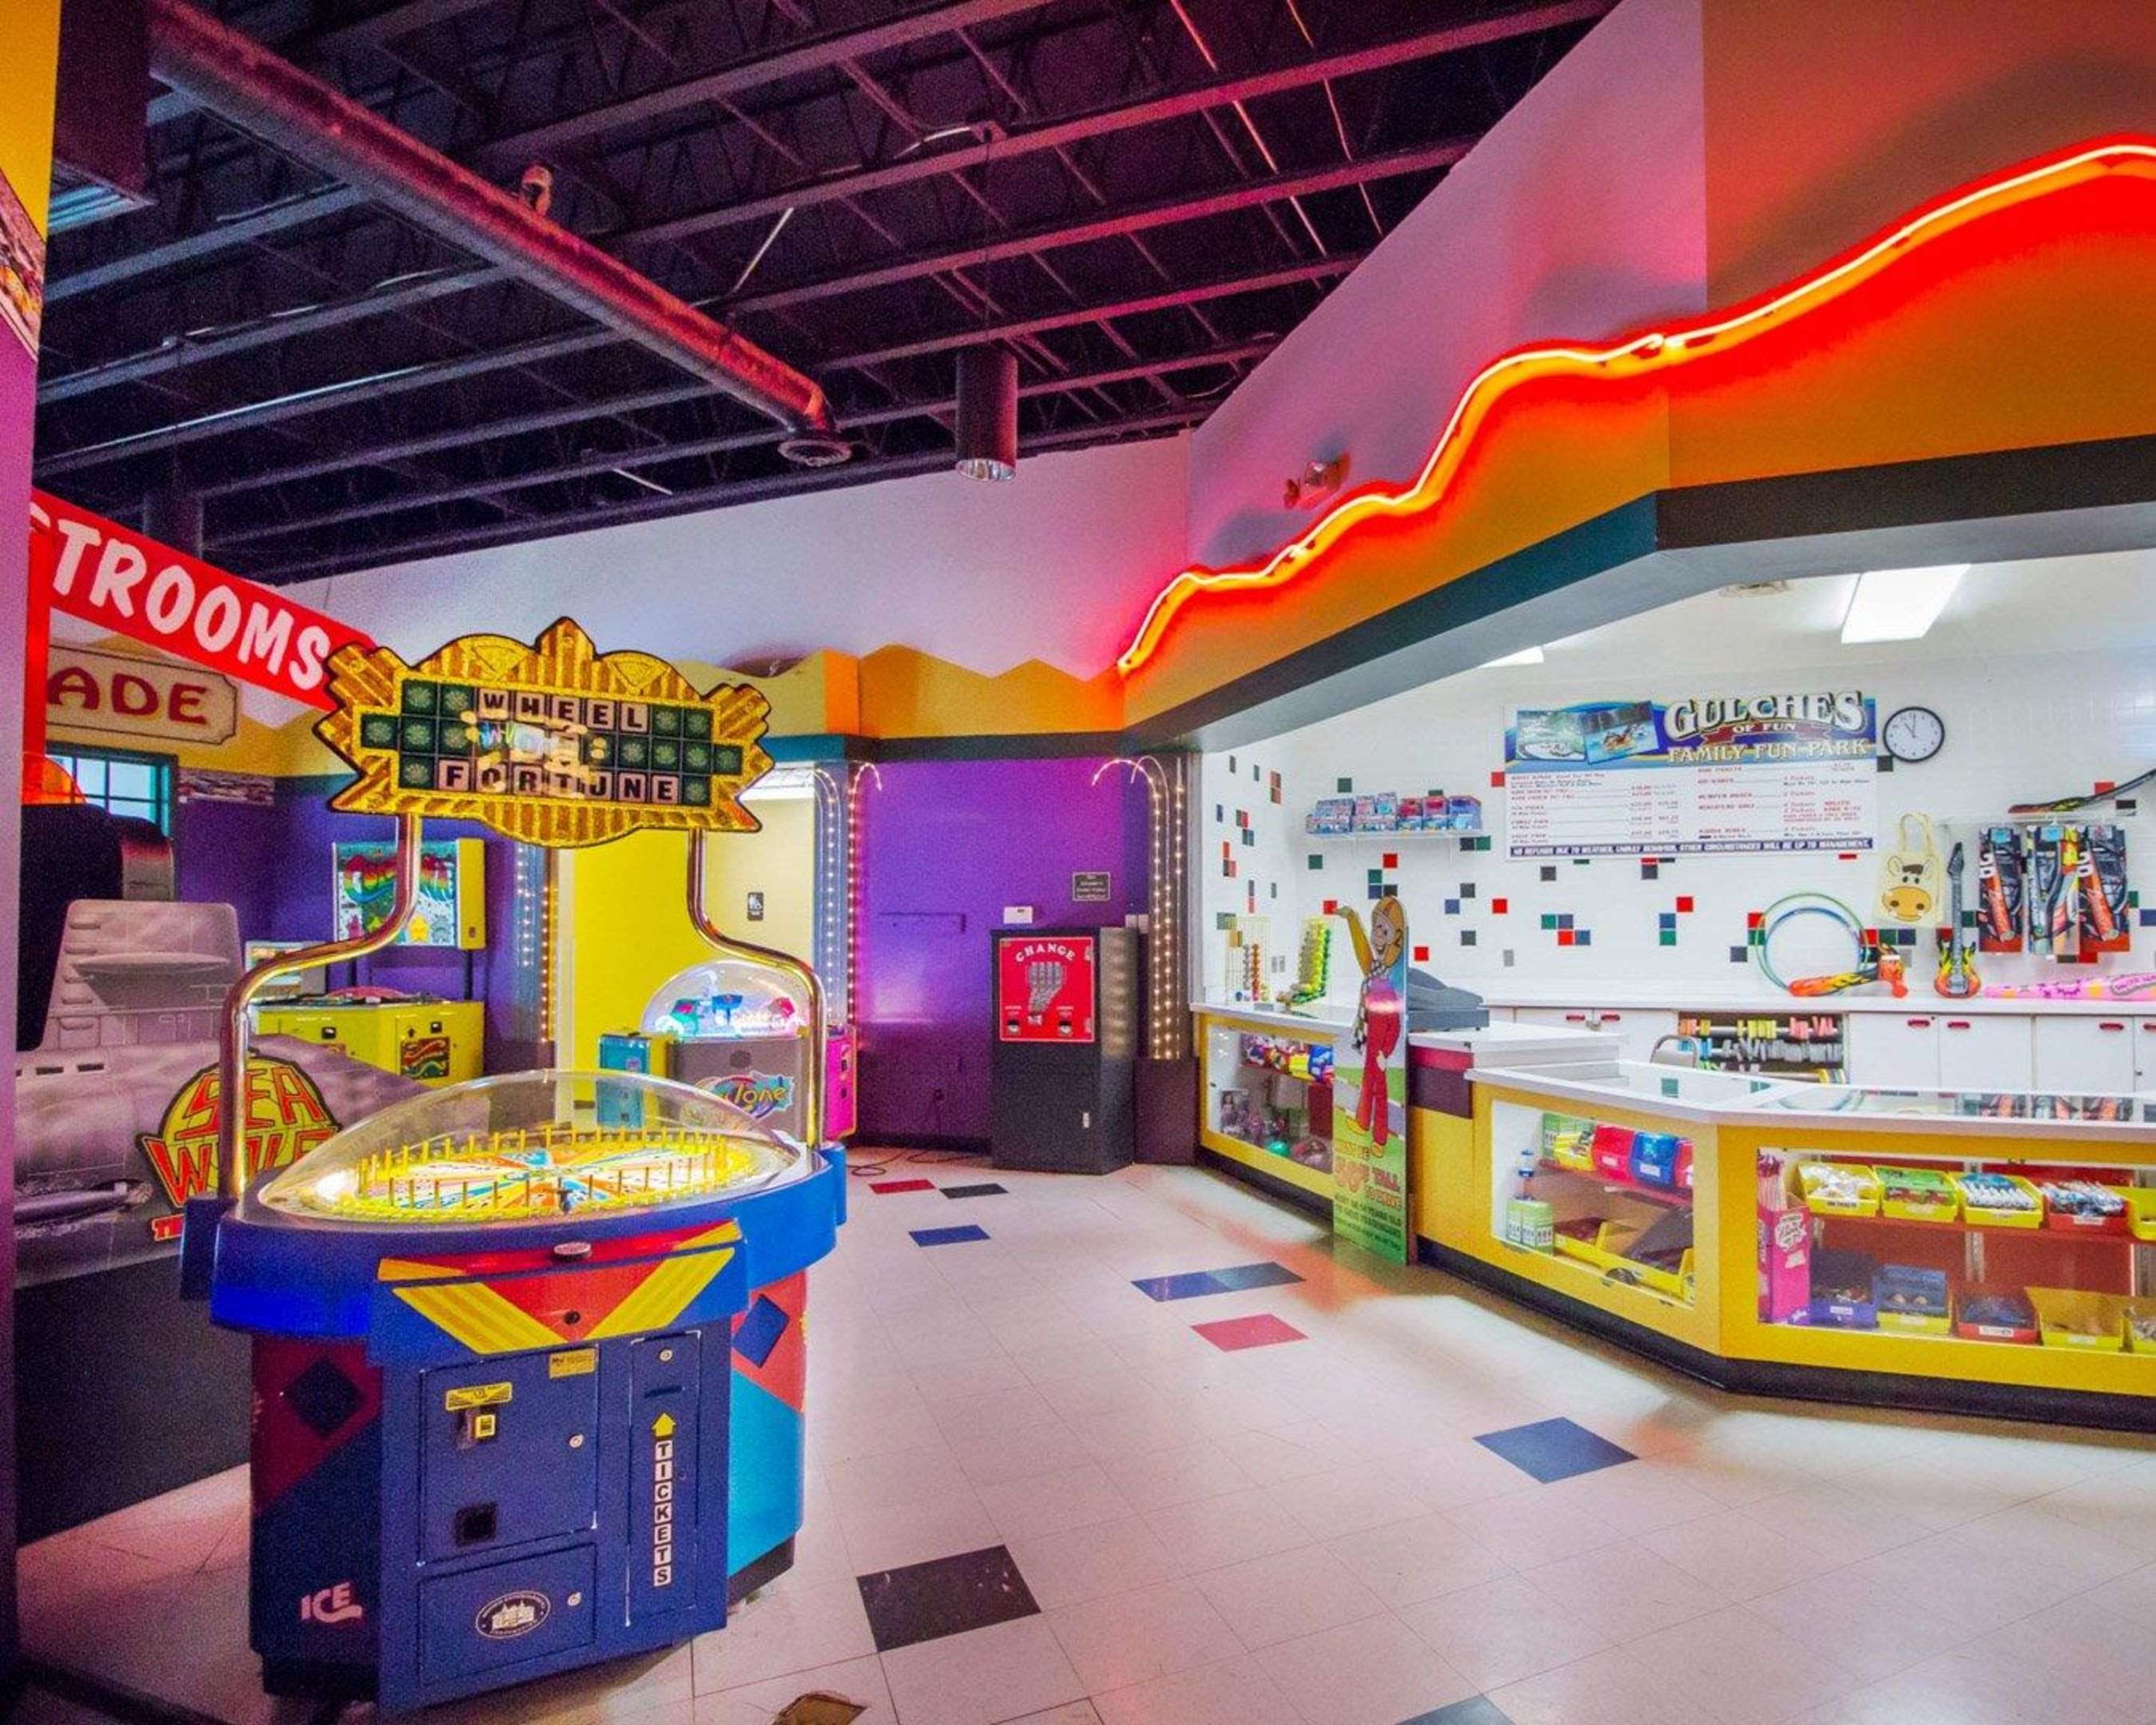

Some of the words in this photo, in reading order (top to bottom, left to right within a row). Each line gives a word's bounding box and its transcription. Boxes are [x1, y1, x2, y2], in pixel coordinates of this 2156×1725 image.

[482, 692, 647, 730] WHEEL
[1664, 690, 1867, 740] GULCHES
[1732, 724, 1755, 734] OF
[1761, 722, 1796, 731] FUN
[1668, 743, 1746, 763] FAMILY
[1753, 741, 1797, 759] FUN
[1807, 737, 1869, 758] PARK
[447, 764, 676, 800] FORTUNE
[1015, 943, 1076, 962] CHANGE
[656, 1442, 671, 1583] TICKETS
[301, 1582, 363, 1624] ICE
